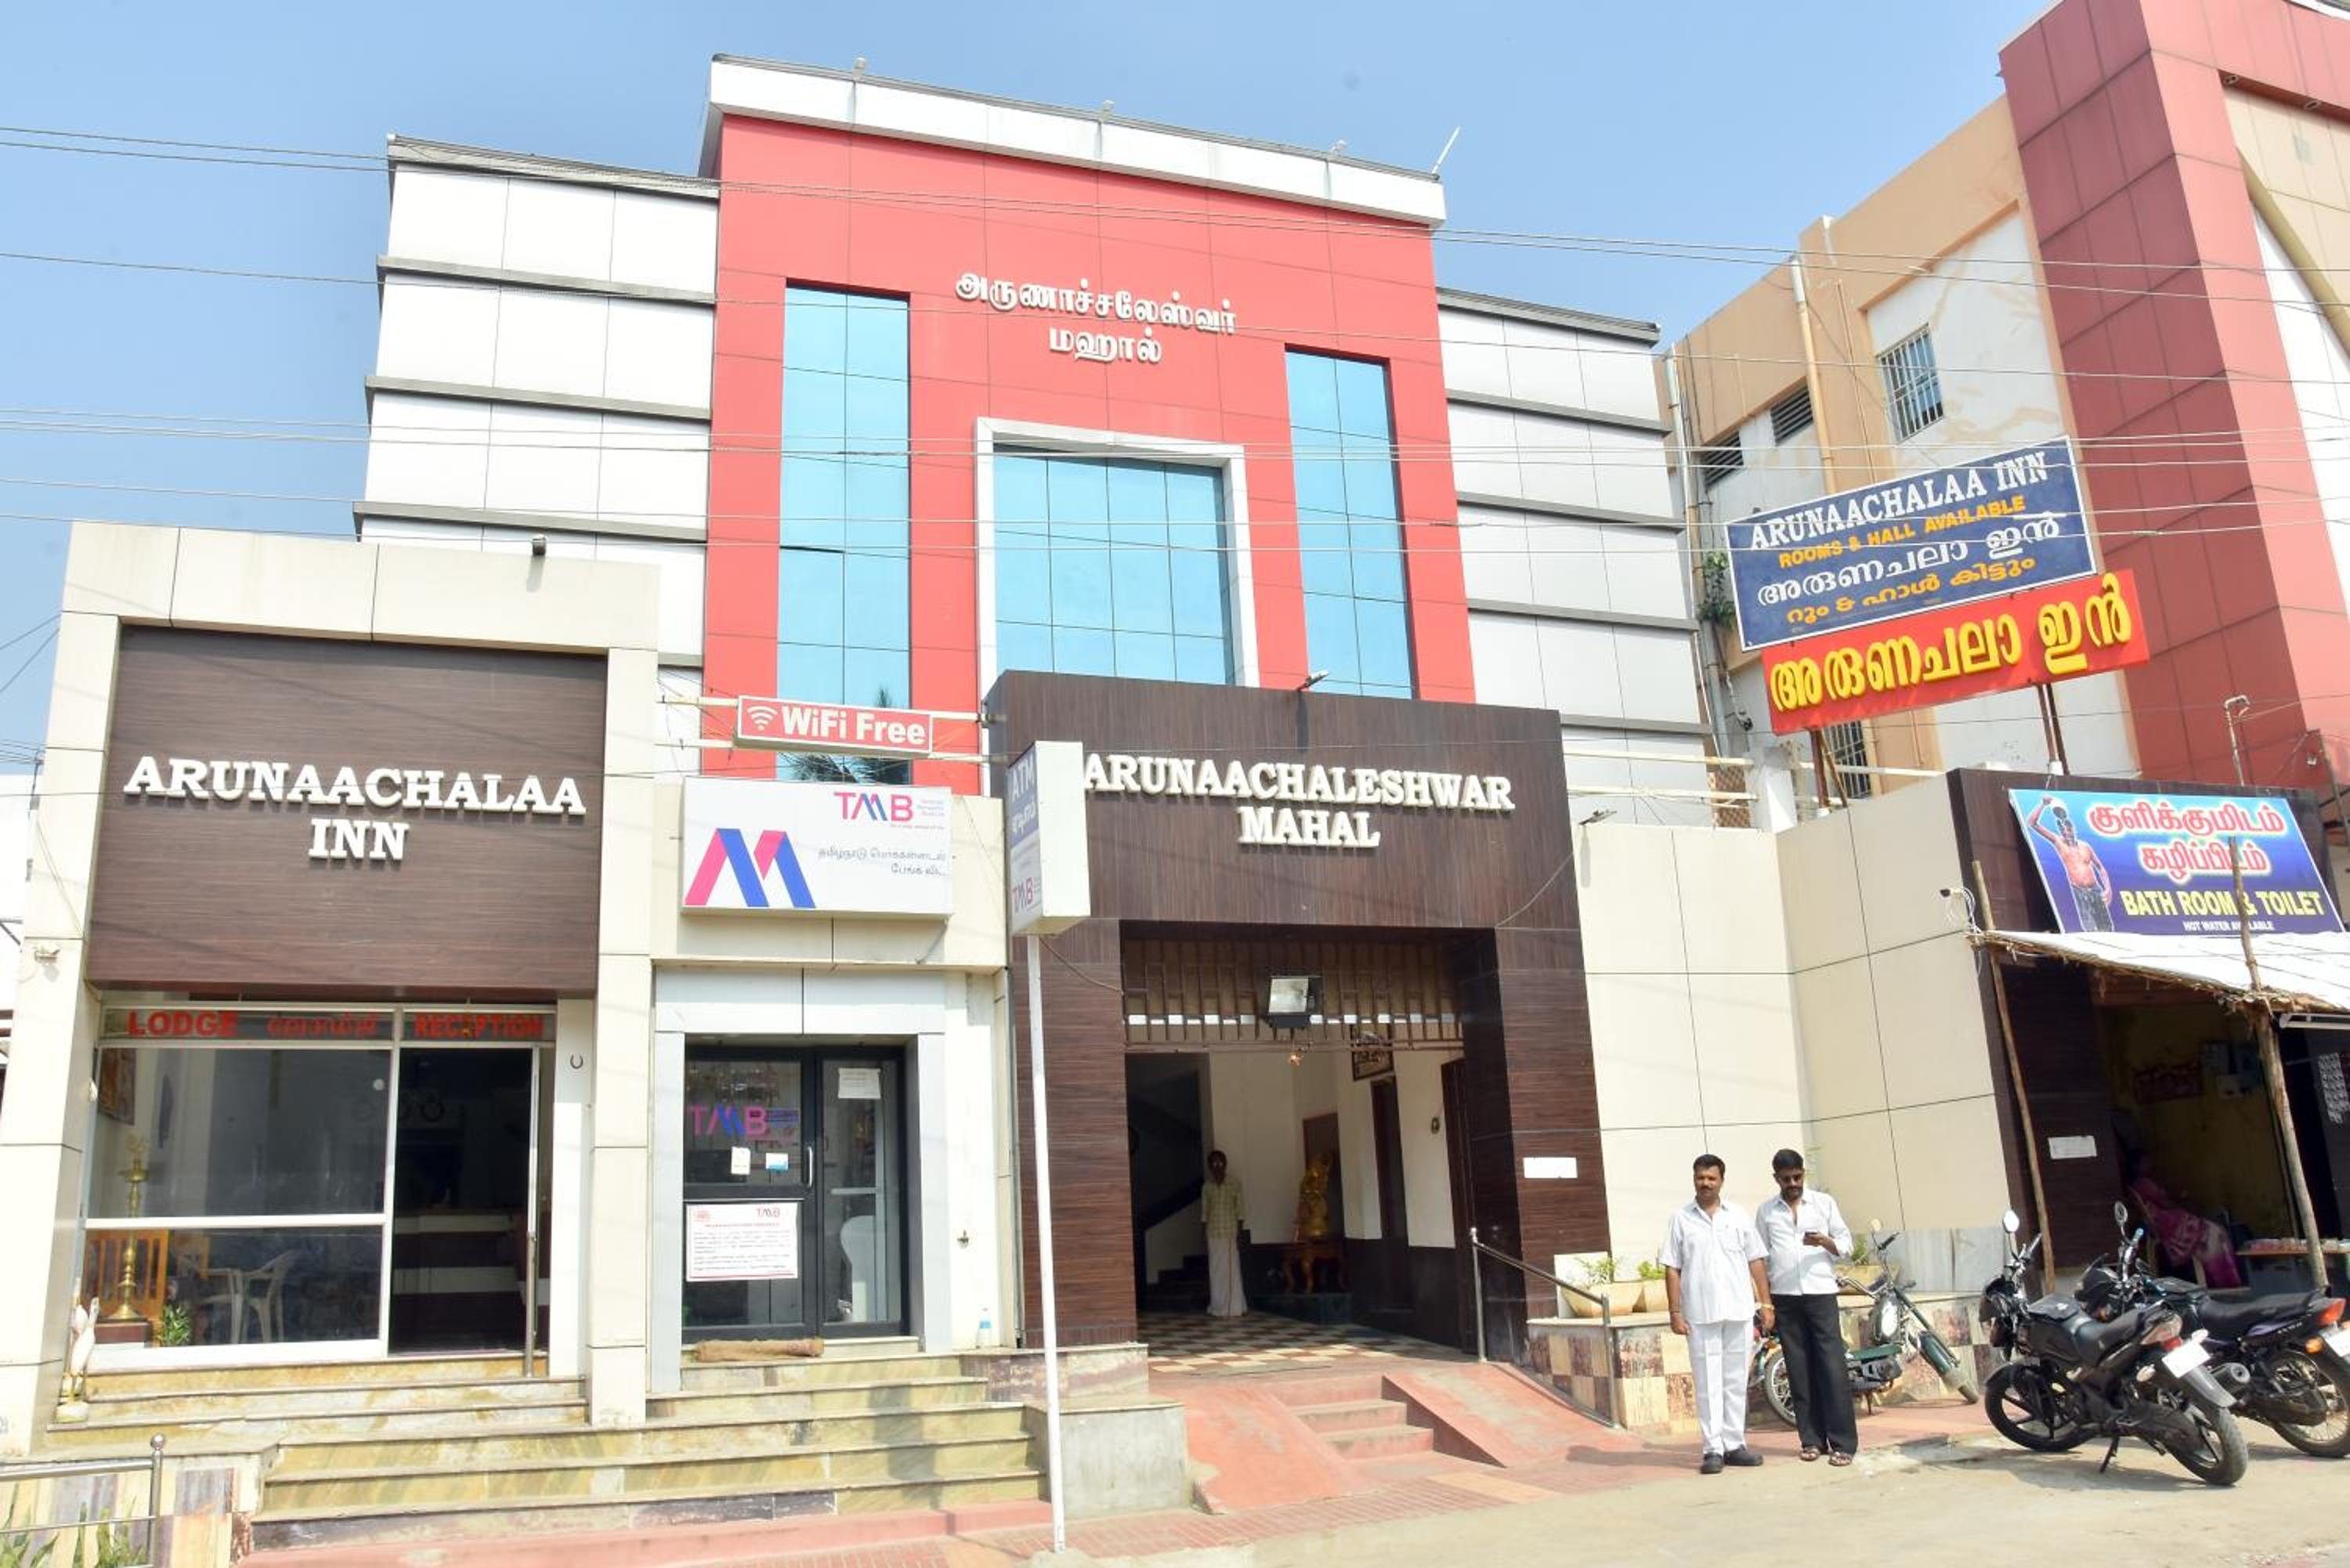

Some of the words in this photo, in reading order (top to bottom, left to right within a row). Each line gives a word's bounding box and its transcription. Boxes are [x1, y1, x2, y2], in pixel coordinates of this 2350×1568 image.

[955, 271, 1237, 334] அருணாச்சலேஸ்வர்
[1049, 327, 1162, 363] மஹால்
[1750, 467, 1987, 551] ARUNAACHALAA
[1995, 452, 2049, 493] INN
[1779, 537, 1843, 568] ROOMS
[1849, 537, 1861, 552] &
[1867, 525, 1916, 547] HALL
[1924, 496, 2026, 534] AVAILABLE
[782, 705, 847, 739] WiFi
[856, 710, 926, 746] Free
[123, 755, 587, 815] ARUNAACHALAA
[1084, 753, 1515, 811] ARUNAACHALESHWAR
[833, 792, 913, 822] TMB
[1238, 806, 1381, 849] MAHAL
[2089, 801, 2286, 836] குளிக்குமிடம்
[308, 818, 410, 862] INN
[2120, 891, 2178, 916] BATH
[2177, 891, 2237, 916] ROOM
[2256, 891, 2325, 916] TOILET
[128, 1010, 239, 1038] LODGE
